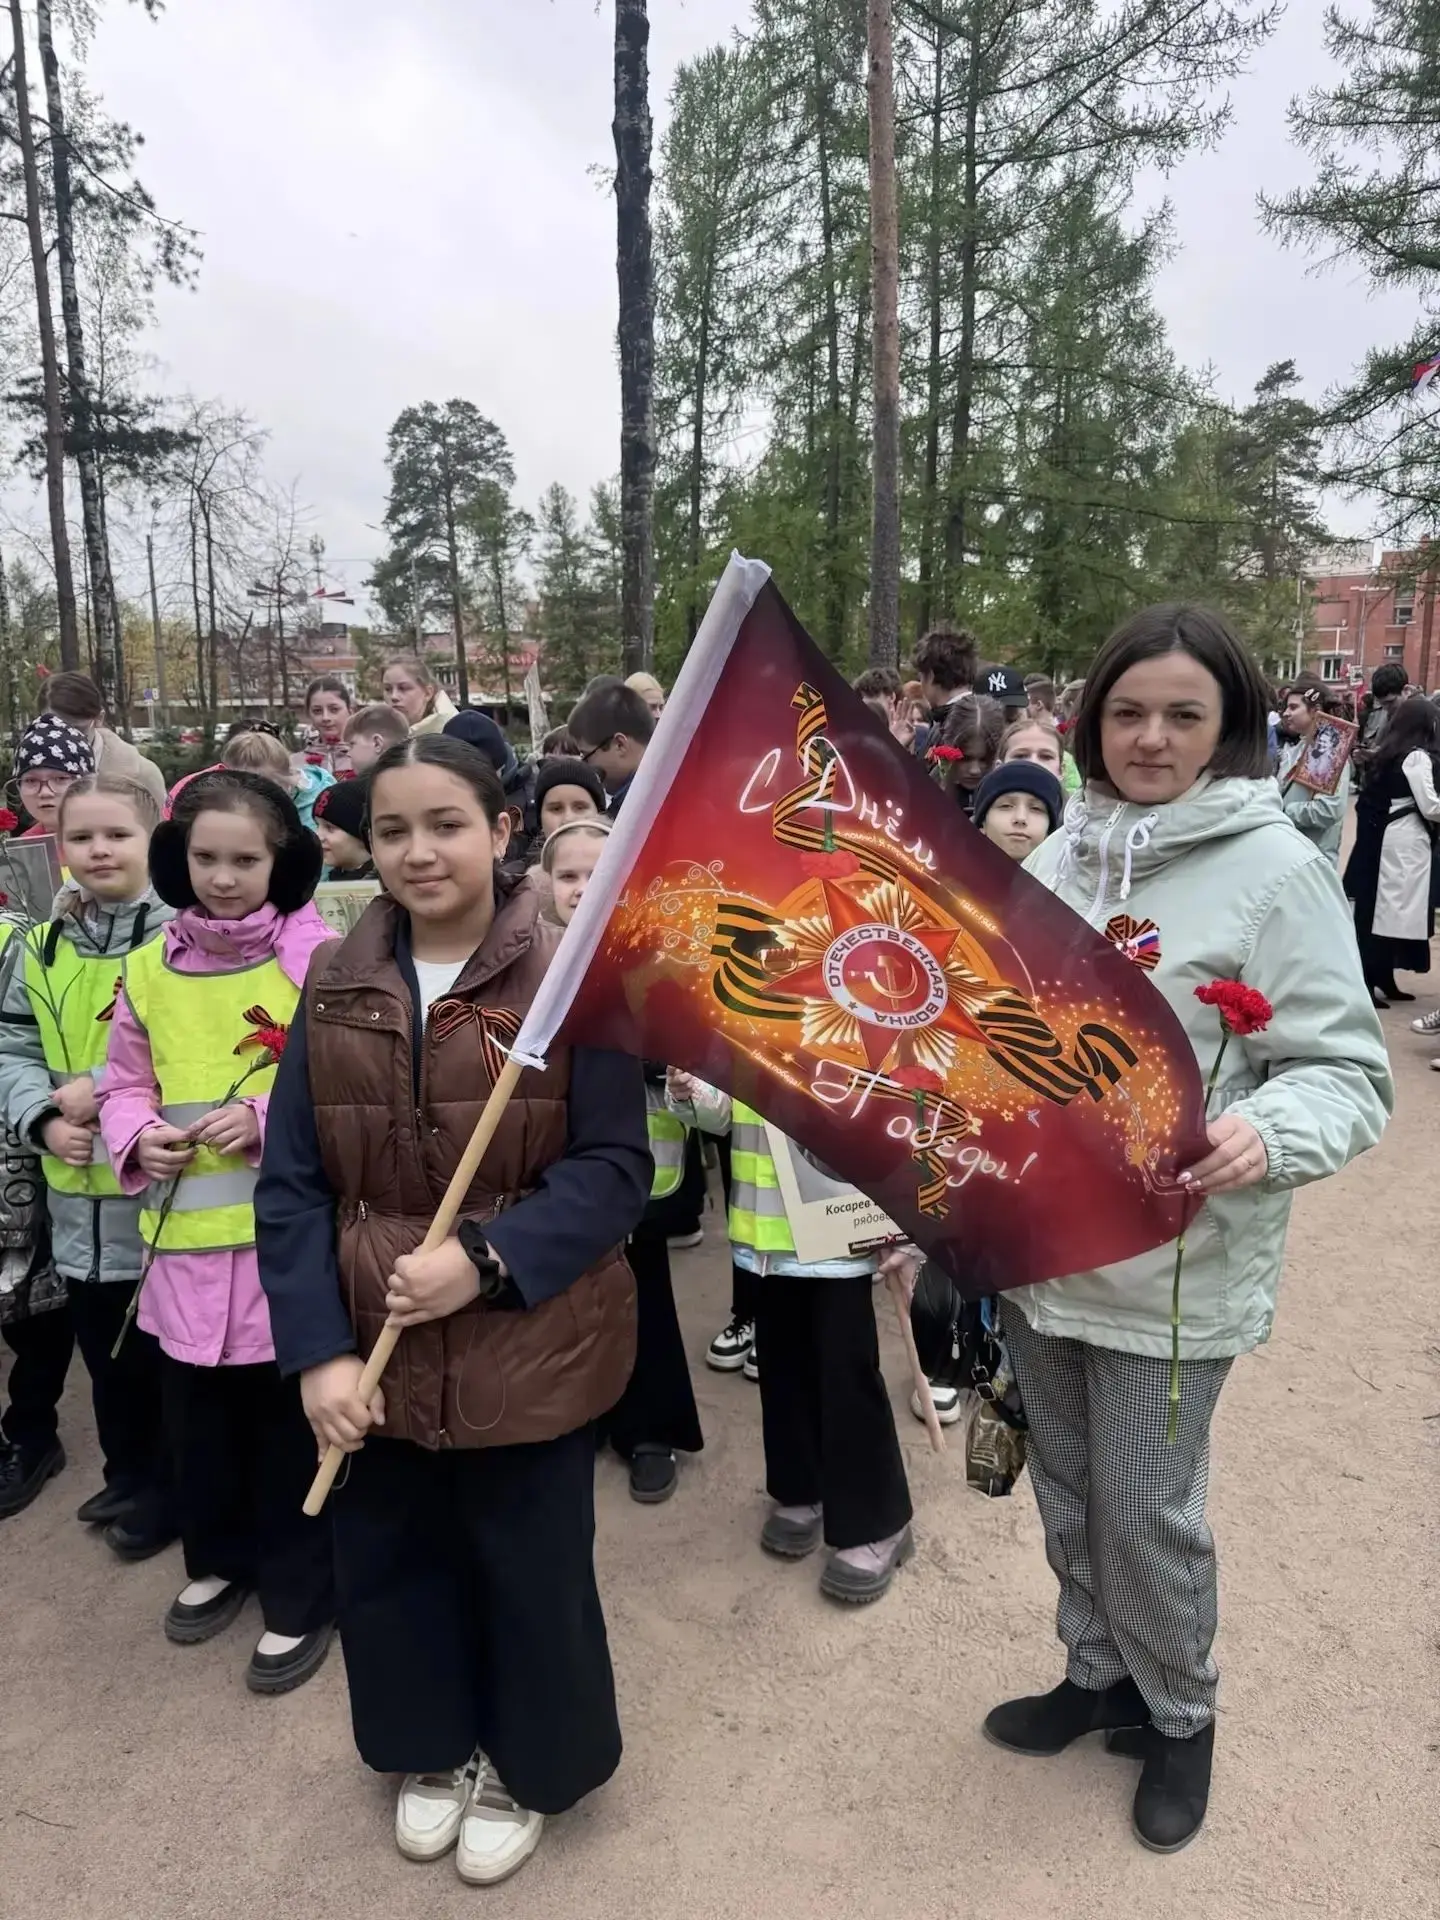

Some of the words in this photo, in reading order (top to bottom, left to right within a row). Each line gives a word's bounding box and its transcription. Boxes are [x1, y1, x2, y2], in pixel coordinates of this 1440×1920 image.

[988, 672, 1007, 691] NY
[828, 927, 944, 999] ОТЕЧЕСТВЕННАЯ
[825, 1199, 871, 1216] Косарев
